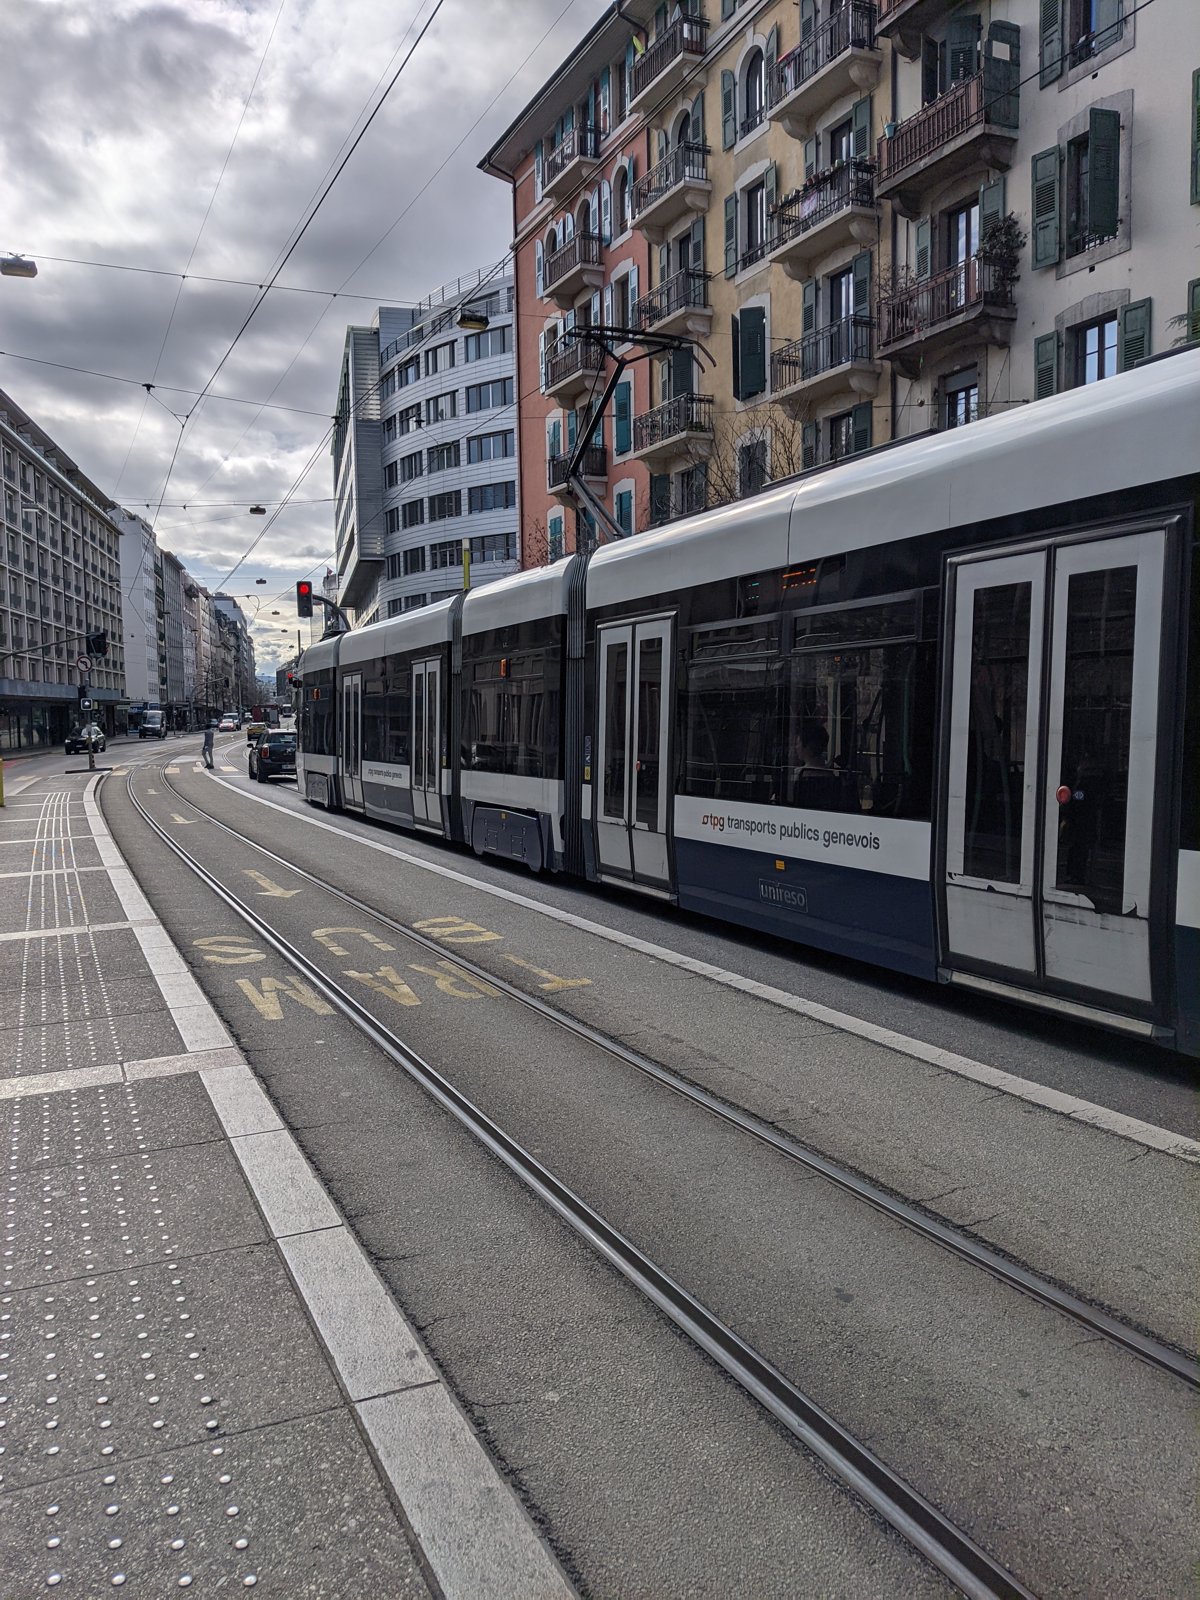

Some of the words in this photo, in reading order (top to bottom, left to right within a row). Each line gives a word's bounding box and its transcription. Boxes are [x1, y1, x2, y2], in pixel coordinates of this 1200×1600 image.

[709, 813, 725, 831] tpg
[727, 815, 776, 836] transports
[779, 822, 820, 841] publics
[822, 830, 880, 850] genevois
[760, 884, 805, 907] unireso
[192, 915, 504, 965] BUS
[236, 953, 593, 1020] TRAM
